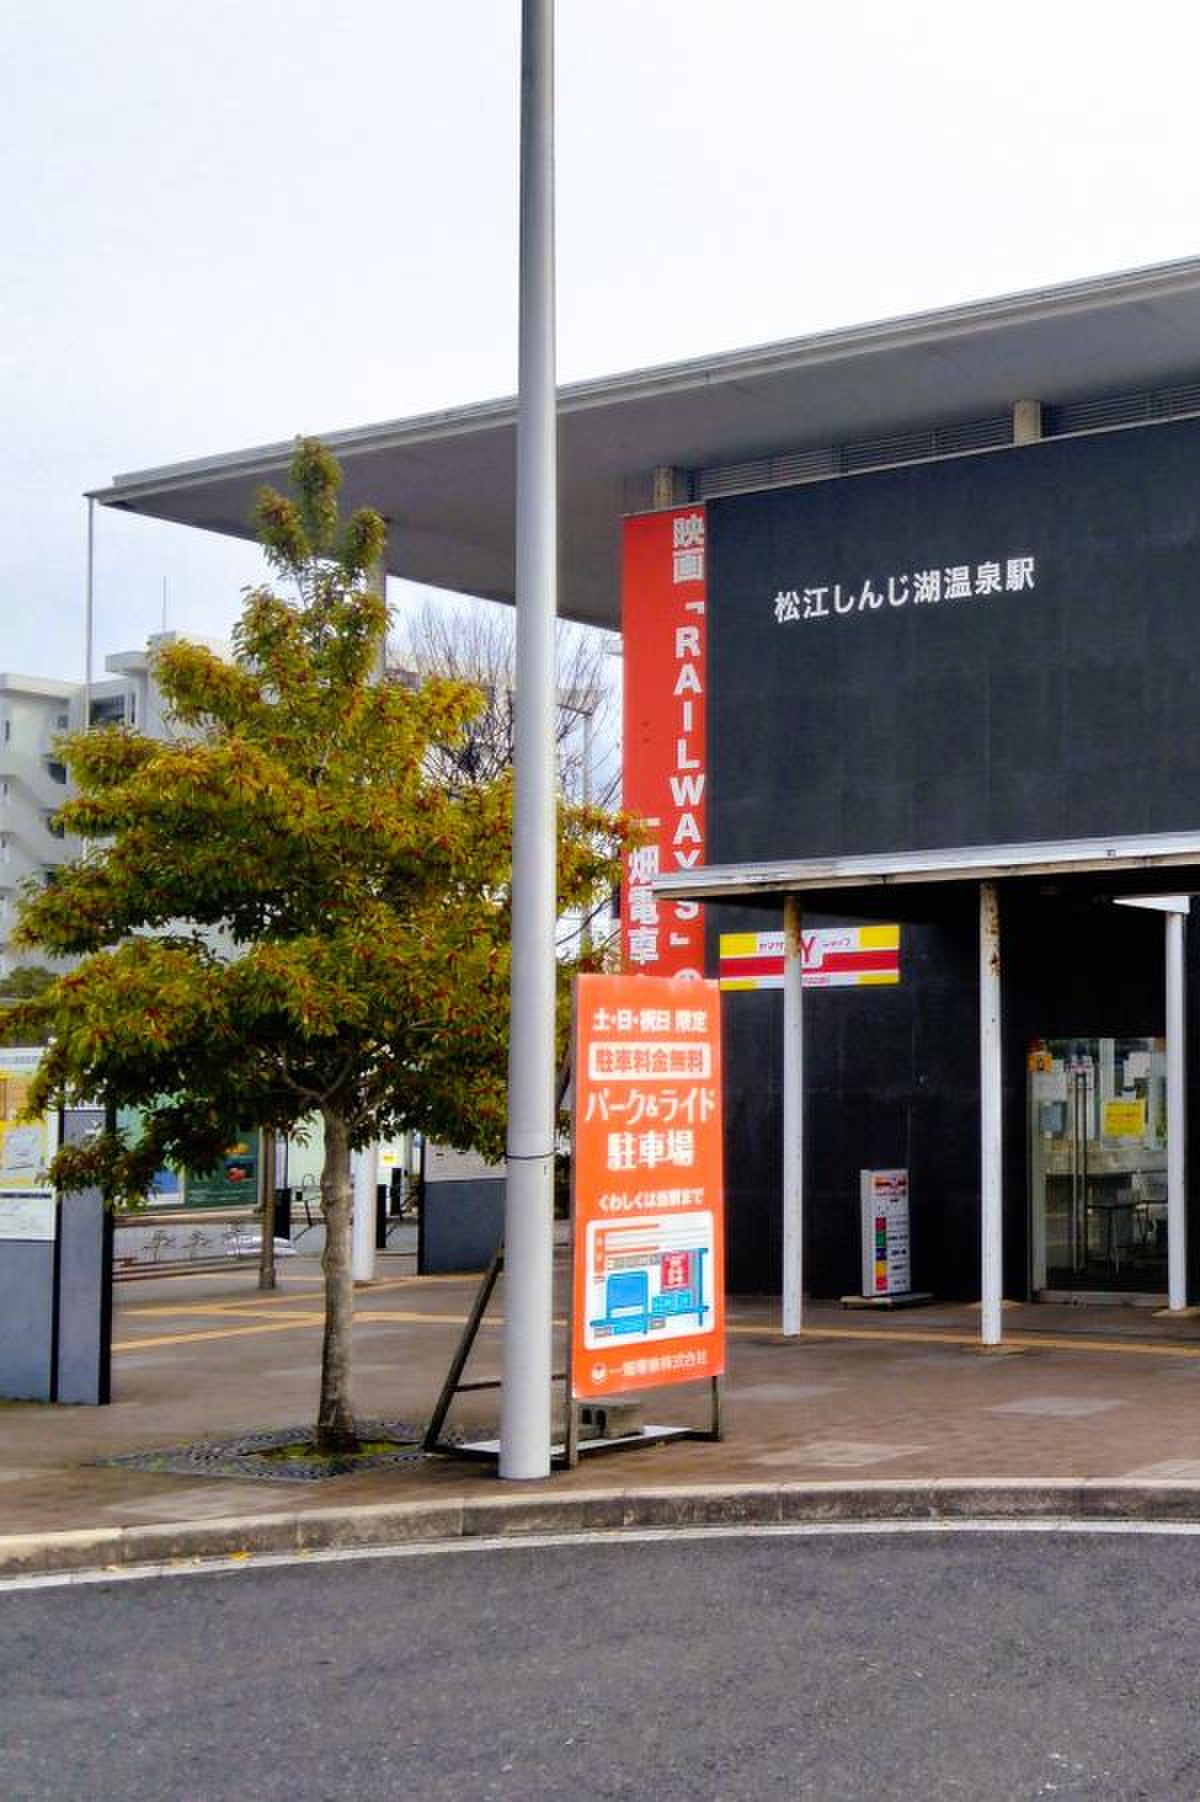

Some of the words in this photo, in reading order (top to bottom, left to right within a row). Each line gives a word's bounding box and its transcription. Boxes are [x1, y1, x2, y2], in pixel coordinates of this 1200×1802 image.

[774, 556, 1036, 623] 松江しんじ湖温泉駅
[627, 818, 660, 977] 一畑電車
[606, 1129, 696, 1171] 駐車場
